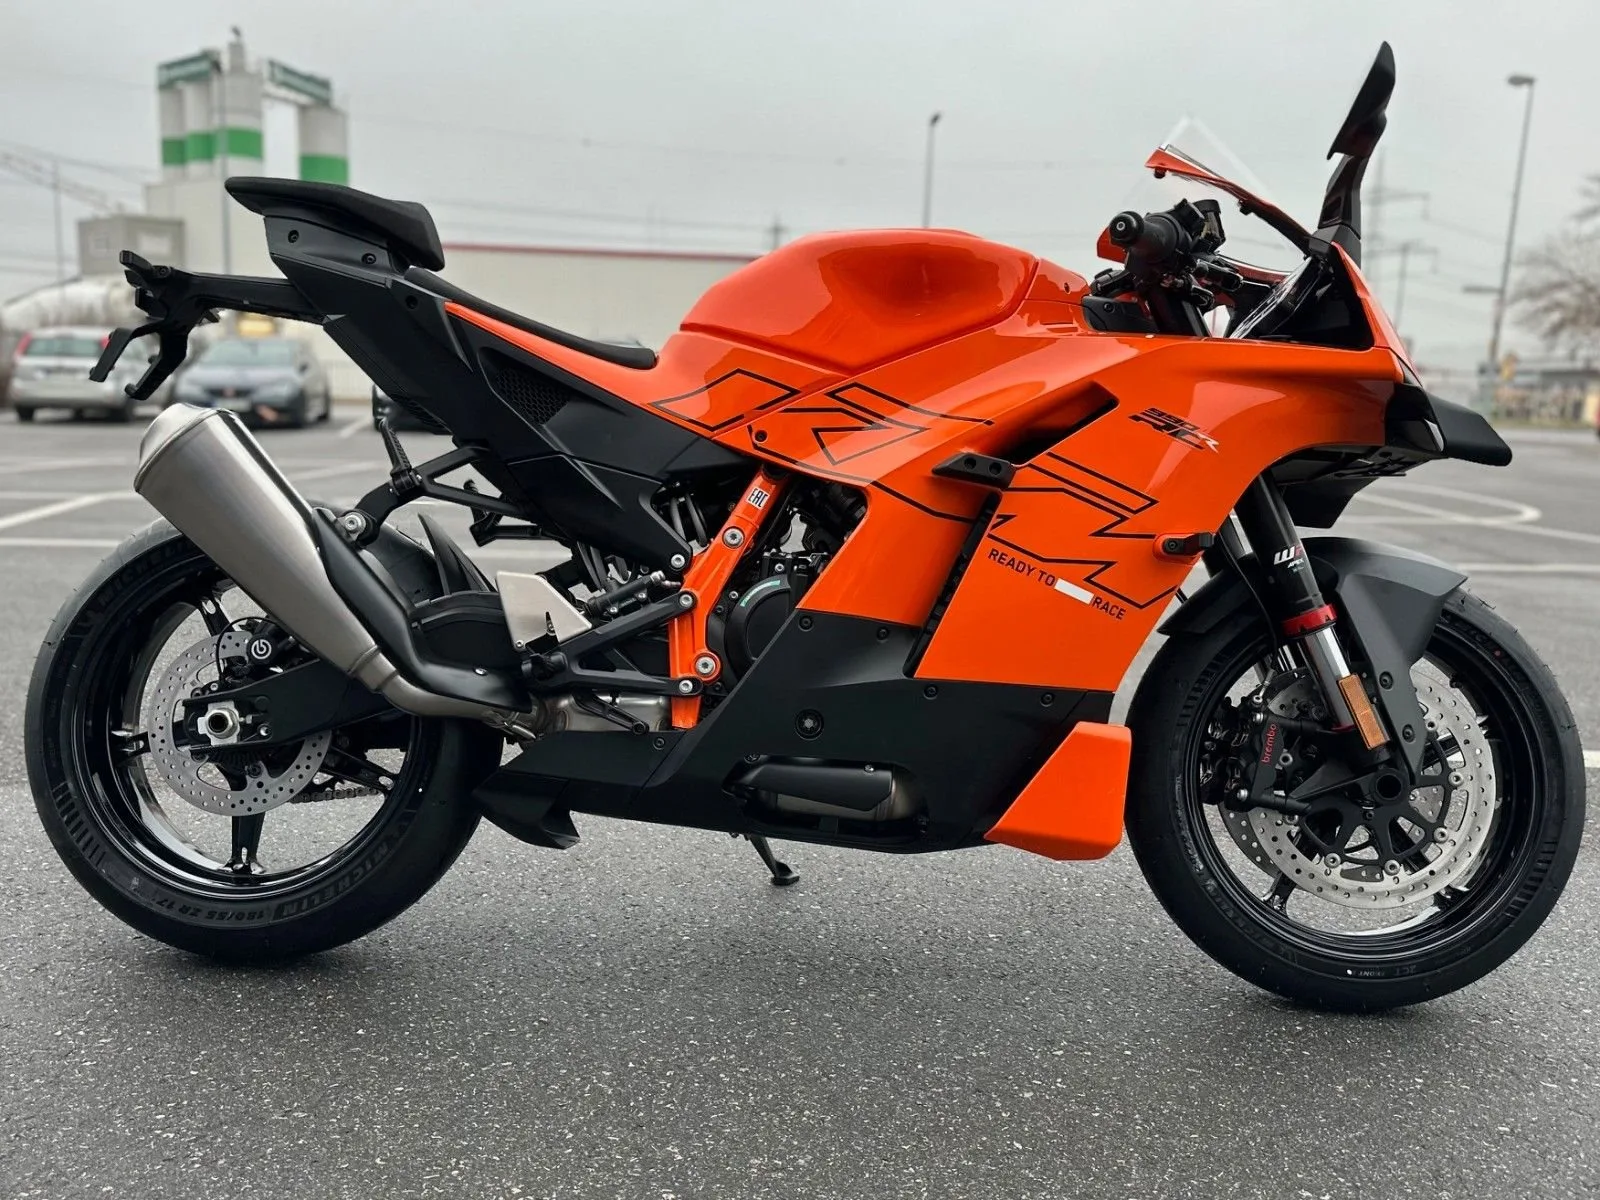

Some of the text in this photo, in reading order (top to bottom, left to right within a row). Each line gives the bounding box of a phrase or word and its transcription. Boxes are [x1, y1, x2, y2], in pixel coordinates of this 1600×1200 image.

[748, 488, 768, 507] EAC
[988, 548, 1128, 620] READY TO RACE
[1261, 723, 1277, 763] brembo
